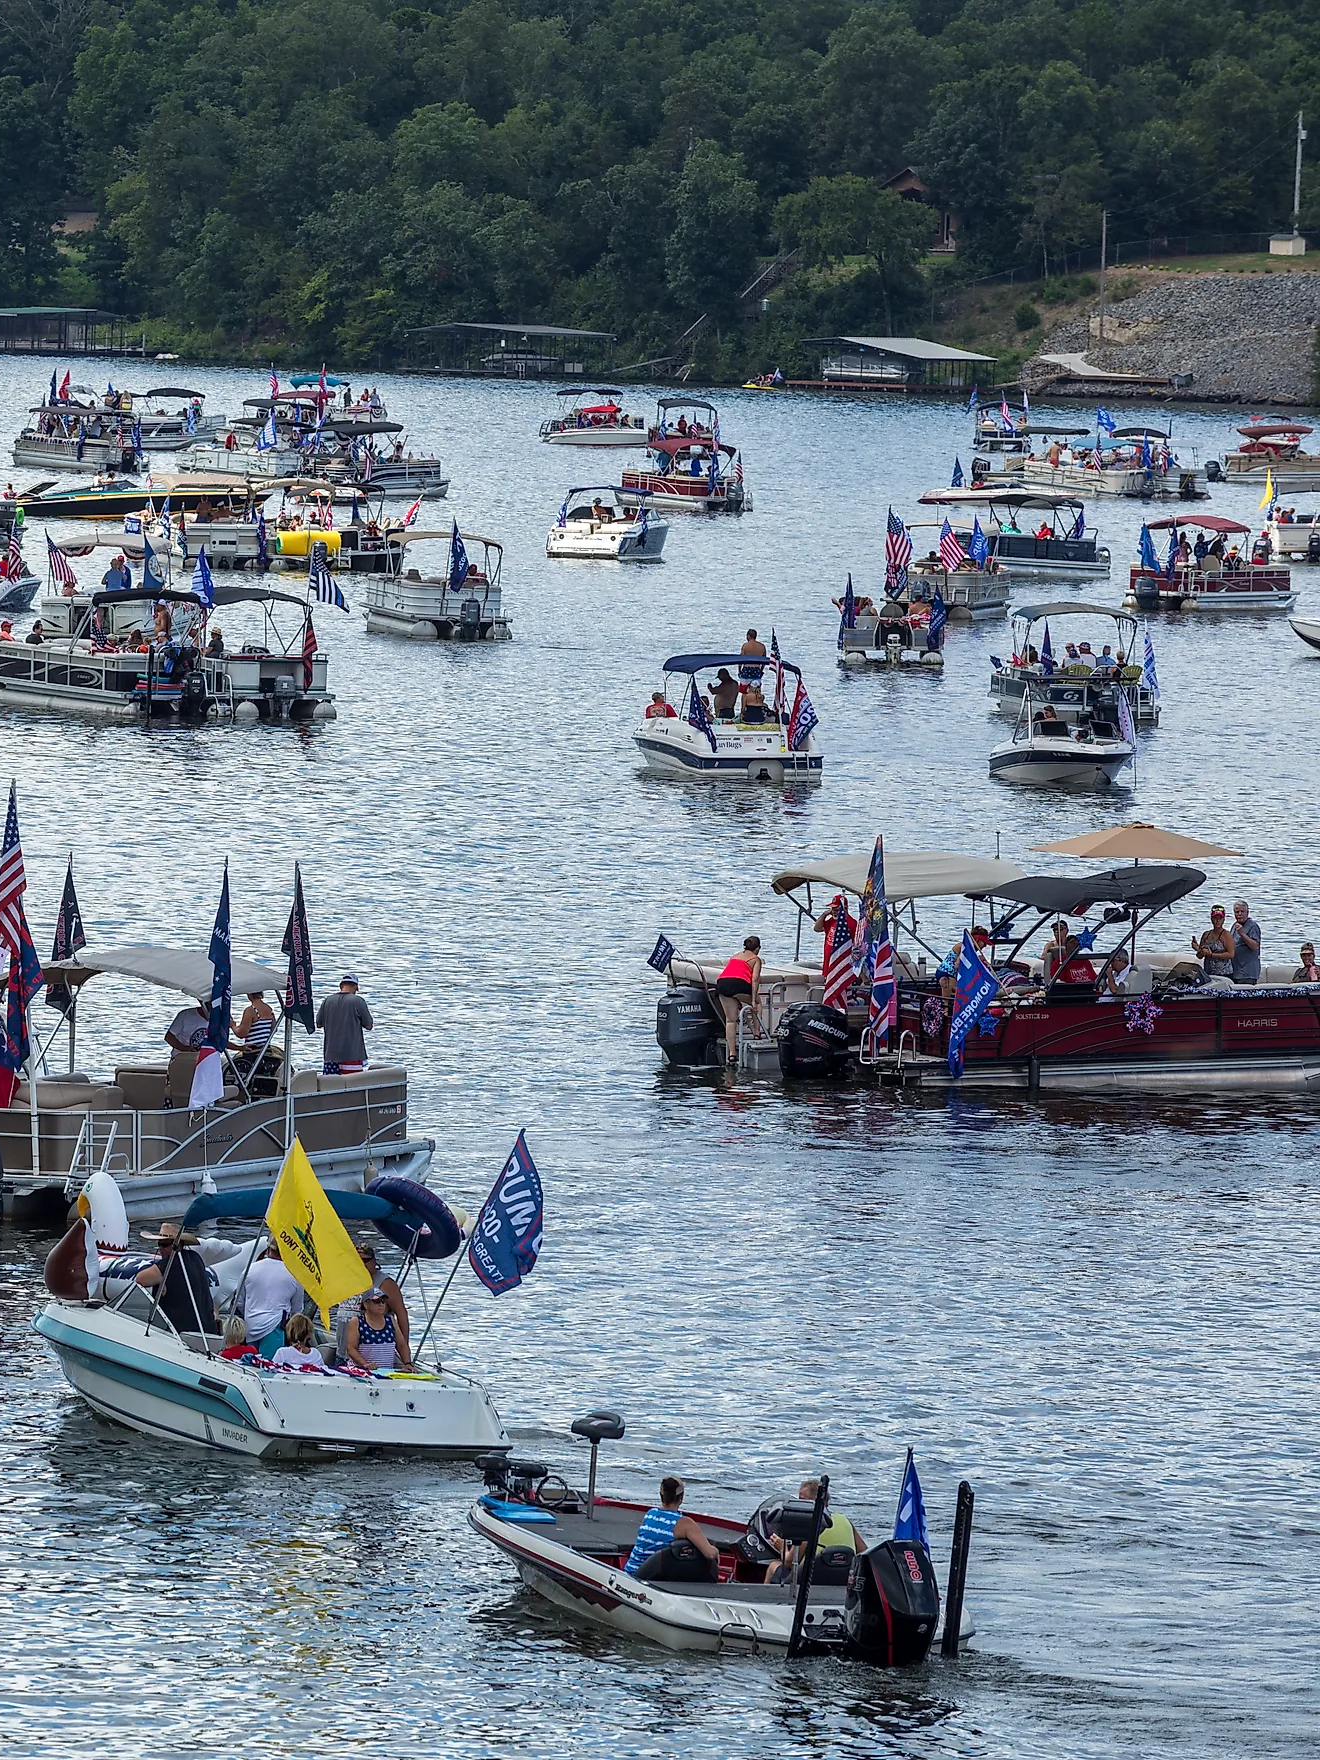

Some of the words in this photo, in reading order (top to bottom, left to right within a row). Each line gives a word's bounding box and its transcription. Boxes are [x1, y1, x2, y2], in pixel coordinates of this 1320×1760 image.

[1063, 691, 1080, 701] G3
[652, 940, 668, 966] TRUMP
[677, 1004, 703, 1014] YAMAHA
[807, 1019, 848, 1041] MERCURY
[1238, 1018, 1278, 1028] HARRIS
[280, 1231, 298, 1252] DONT
[296, 1247, 317, 1275] TREAD
[476, 1242, 505, 1284] GREAT!
[222, 1427, 248, 1444] INVADER
[615, 1583, 639, 1600] Ranger
